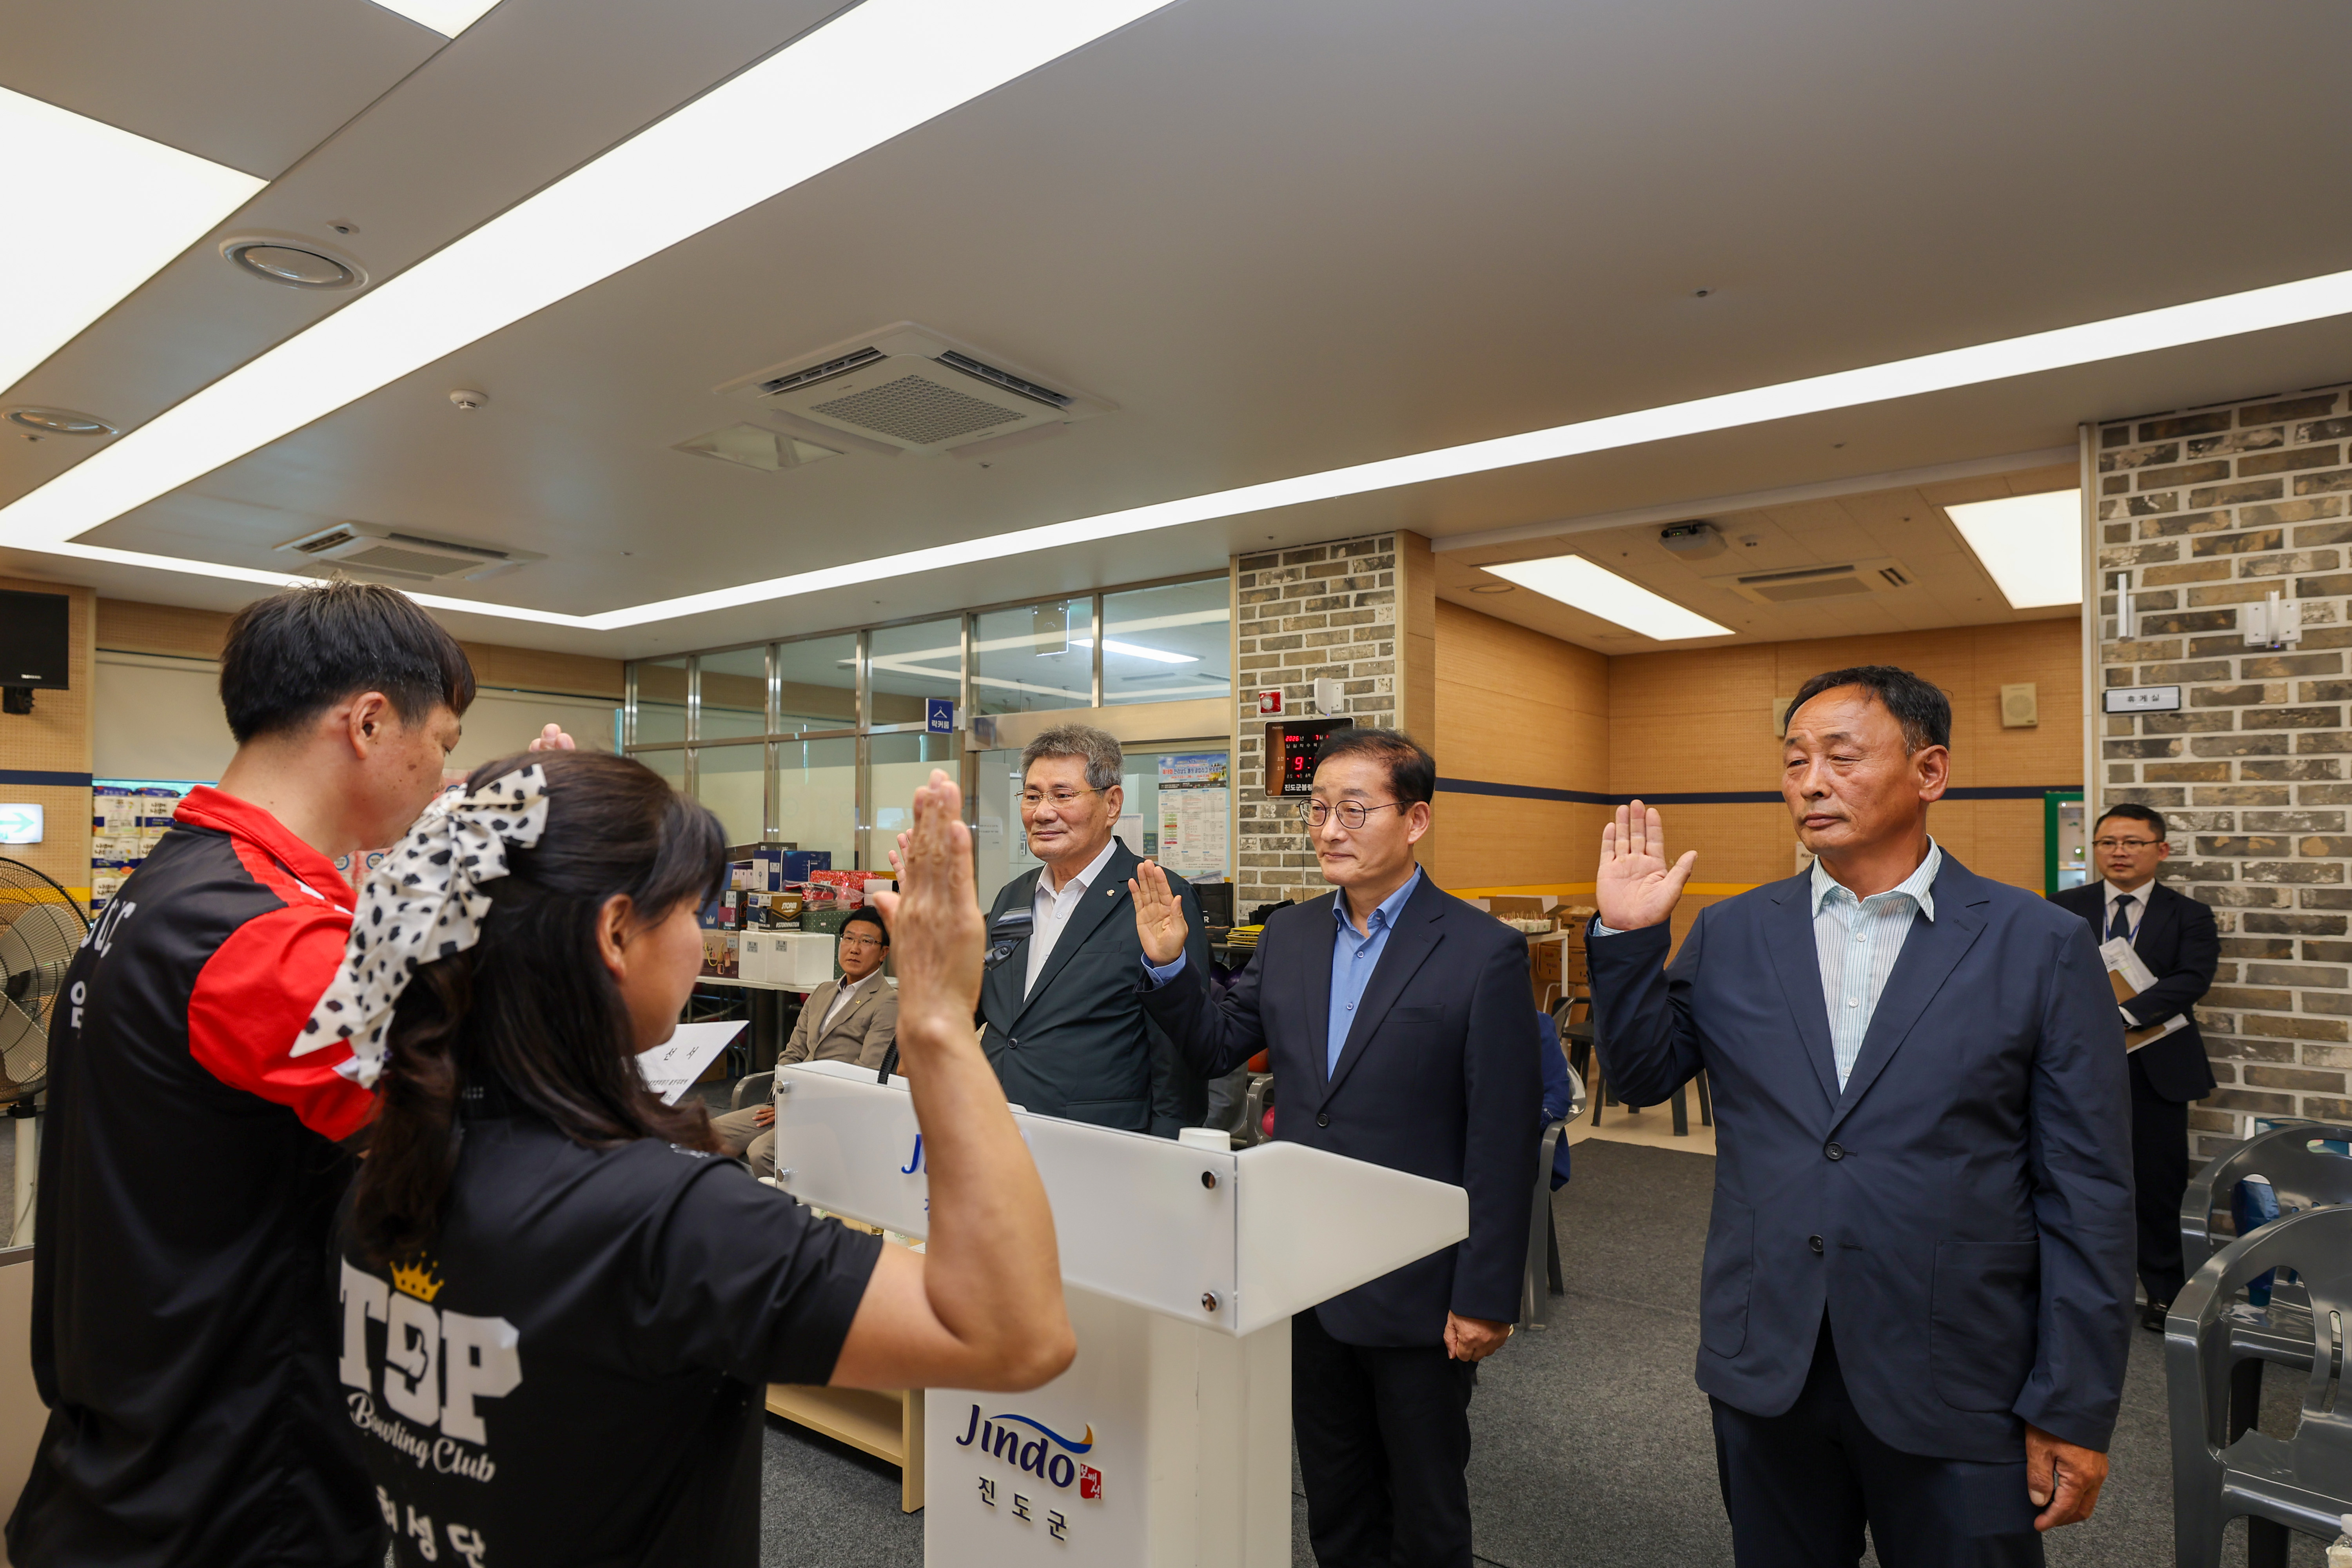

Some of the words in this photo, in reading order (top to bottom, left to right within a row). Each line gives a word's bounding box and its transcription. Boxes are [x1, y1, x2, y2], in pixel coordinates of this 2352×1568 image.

[931, 720, 949, 729] 락커룸
[339, 1254, 523, 1445] TOP
[347, 1391, 431, 1469] Bowling
[432, 1437, 497, 1483] Club
[956, 1405, 1075, 1488] Jindo
